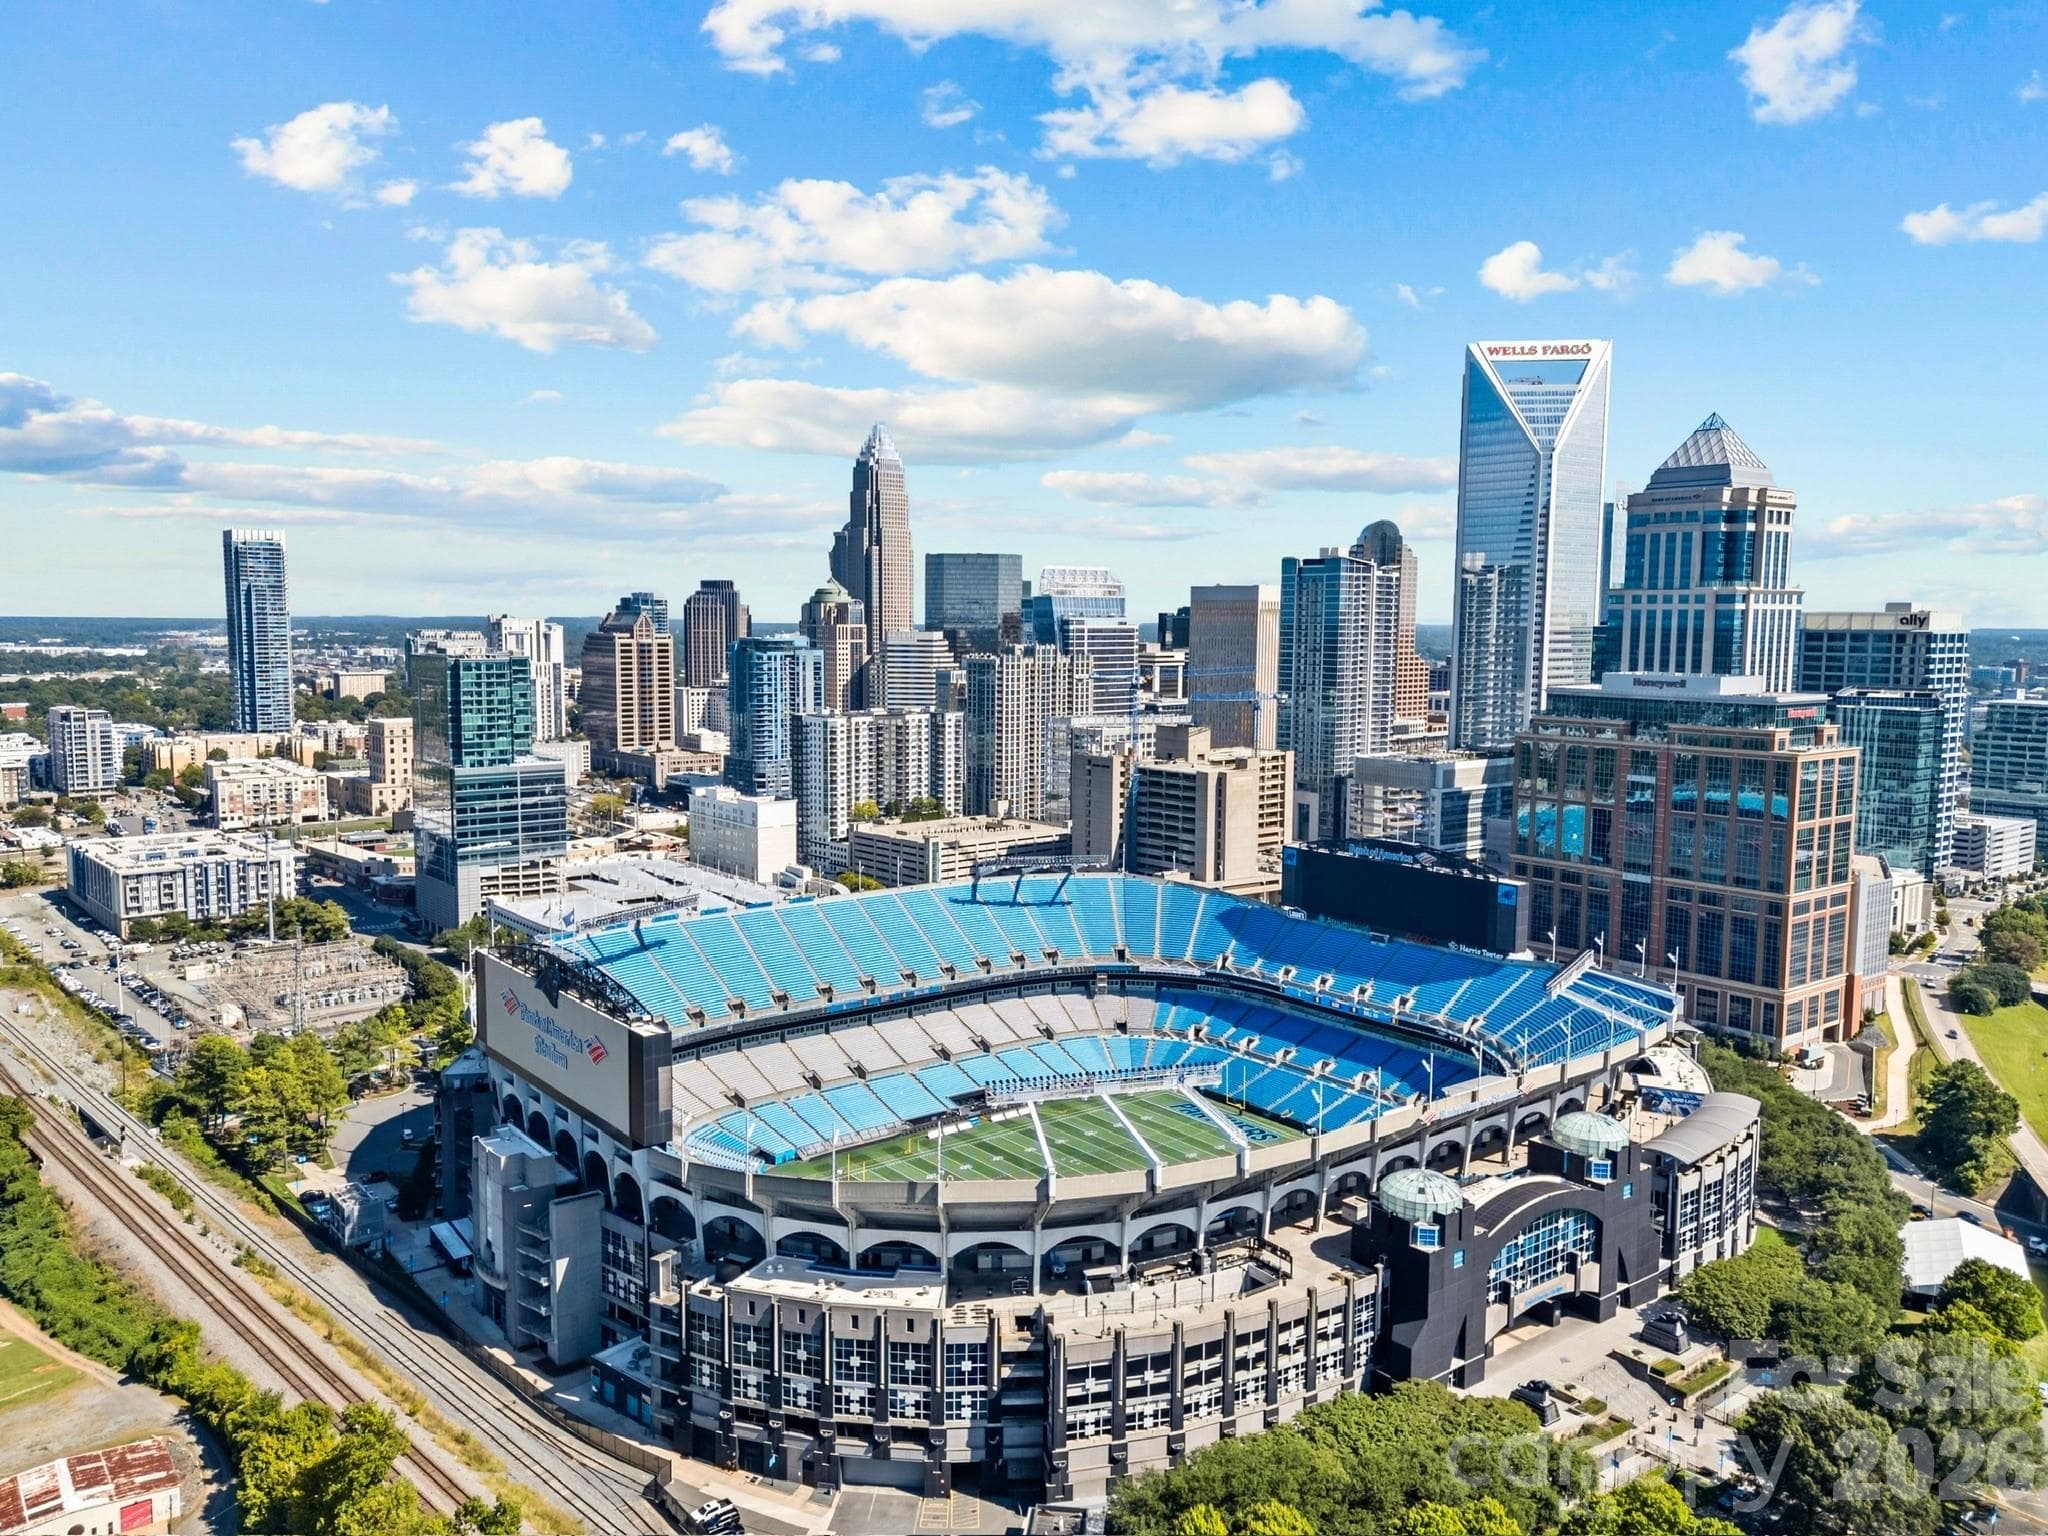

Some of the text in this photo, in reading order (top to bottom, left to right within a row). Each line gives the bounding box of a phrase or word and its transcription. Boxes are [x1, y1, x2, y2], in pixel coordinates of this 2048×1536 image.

[1486, 343, 1592, 356] WELLS FARGO
[1899, 613, 1928, 628] ally
[1633, 677, 1687, 690] Honeywell
[1459, 944, 1504, 961] Harris Teeter
